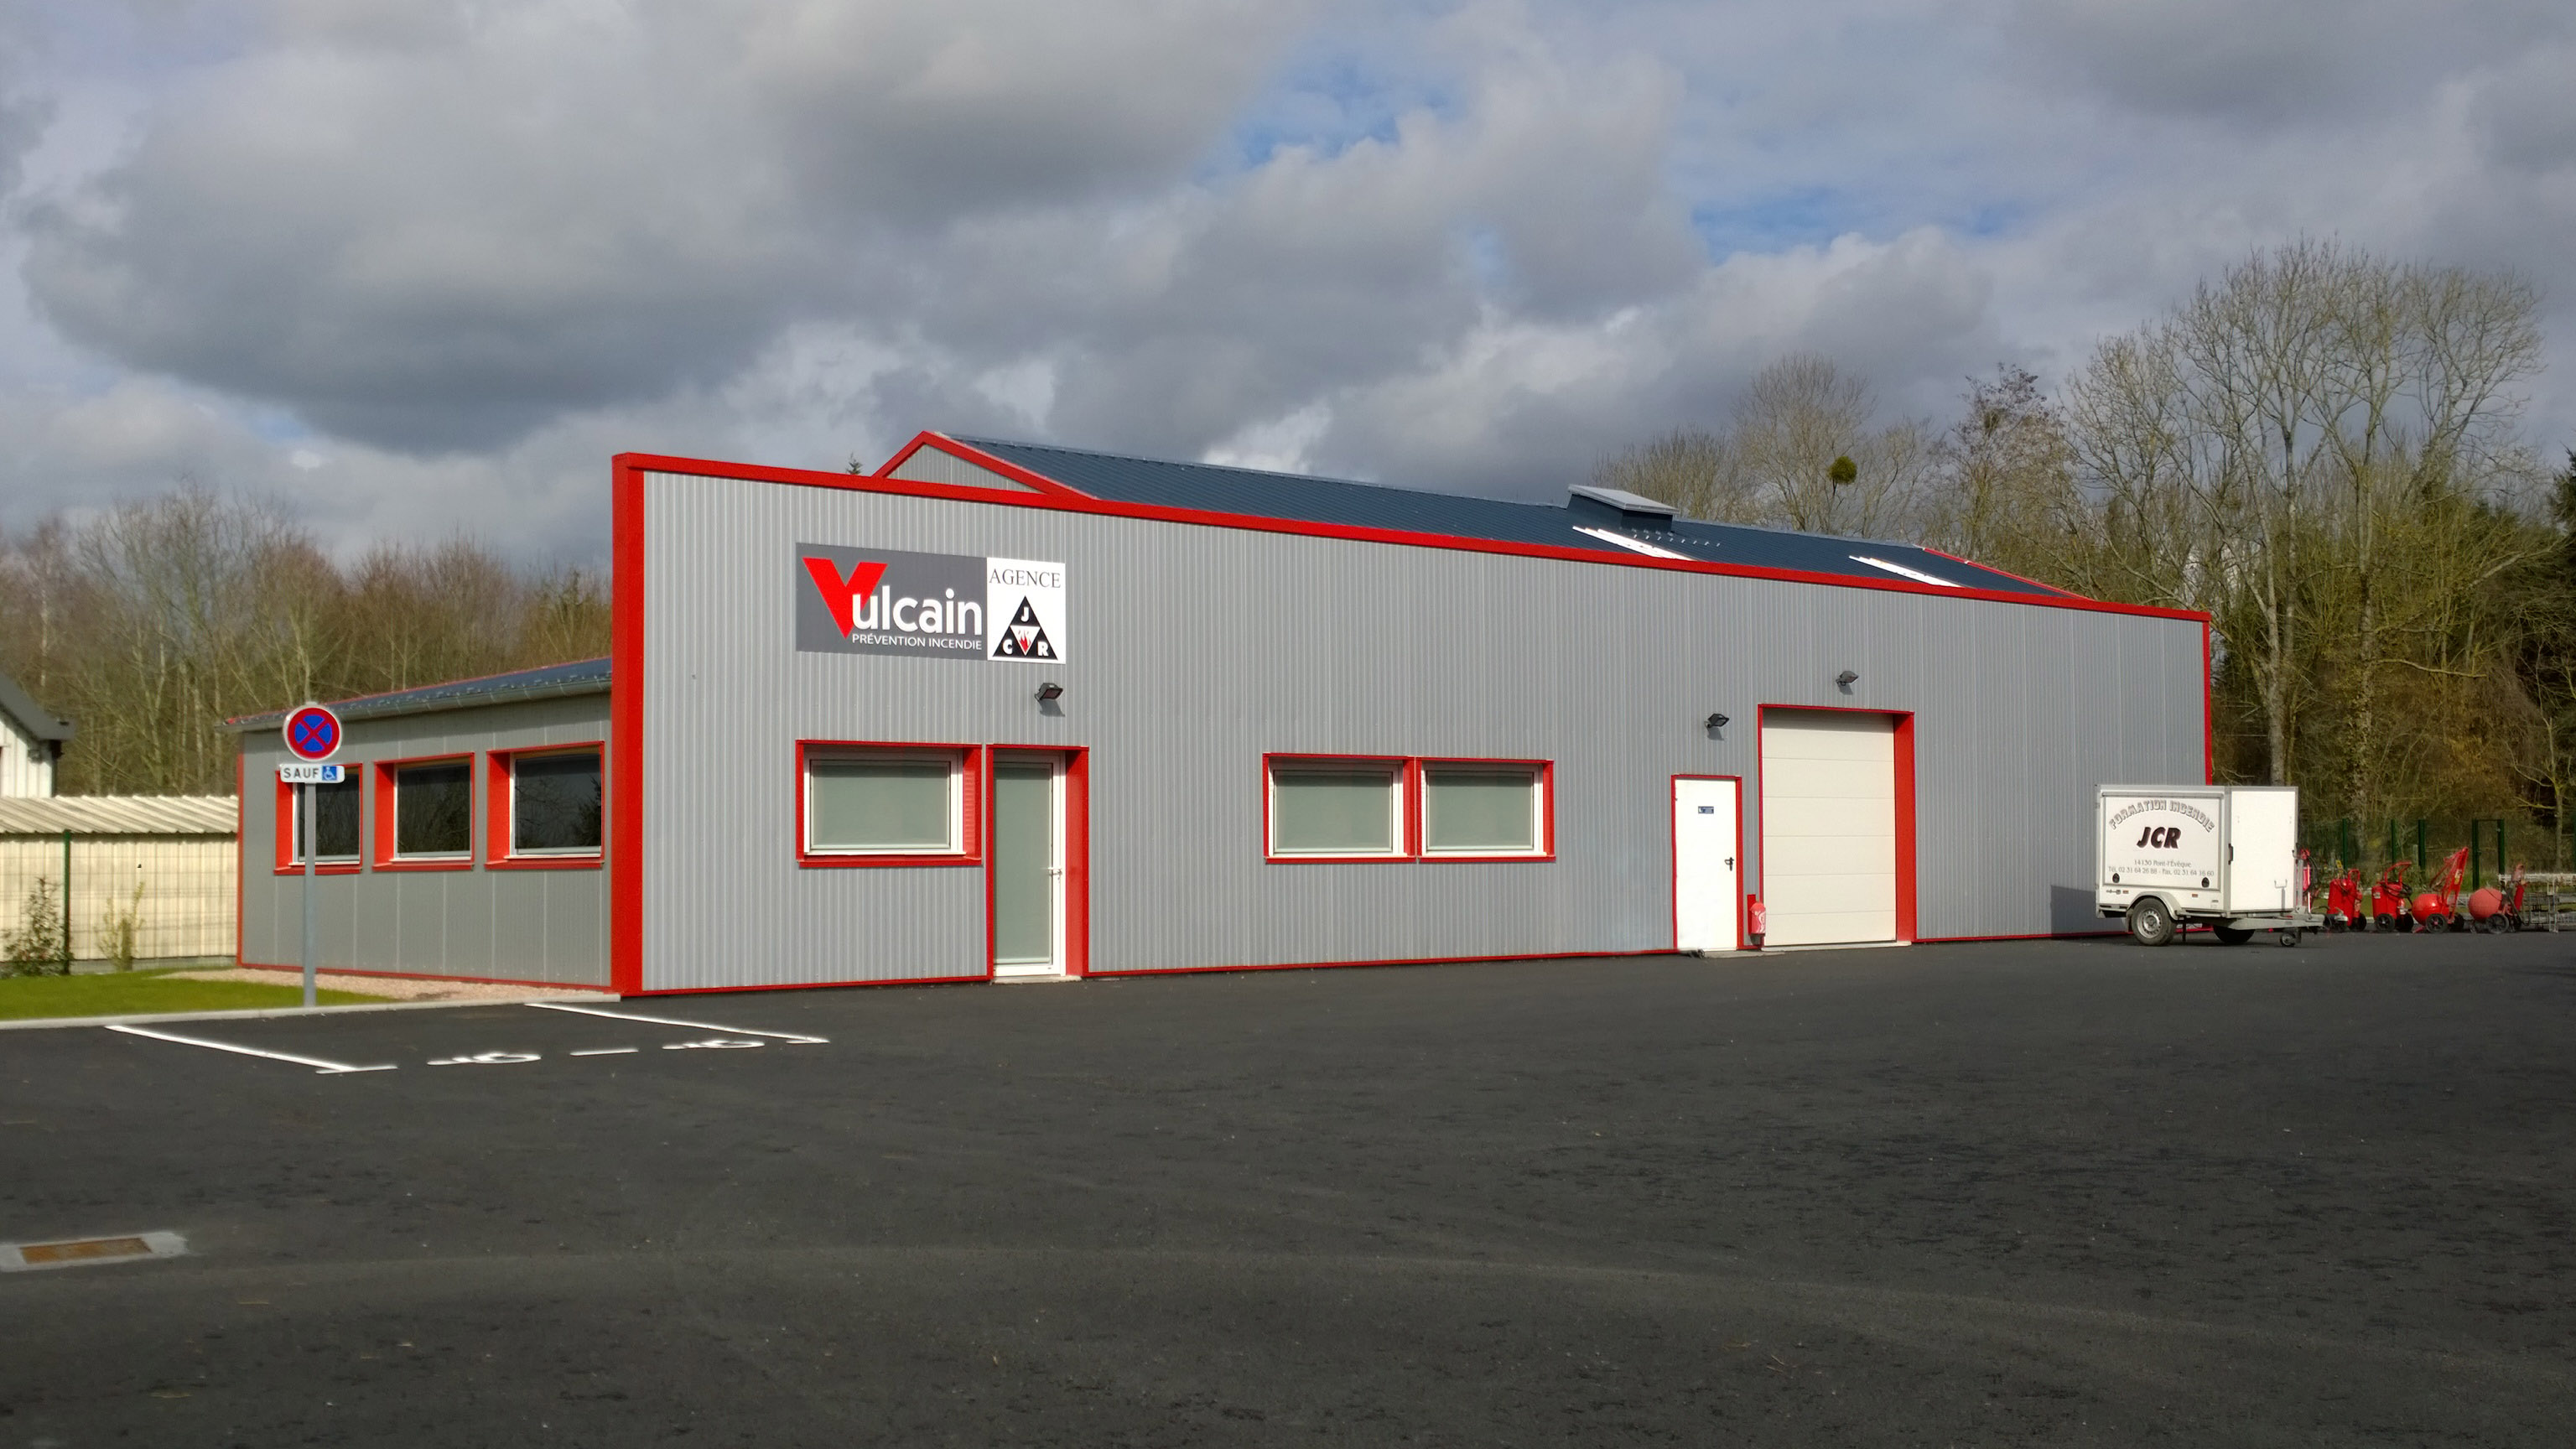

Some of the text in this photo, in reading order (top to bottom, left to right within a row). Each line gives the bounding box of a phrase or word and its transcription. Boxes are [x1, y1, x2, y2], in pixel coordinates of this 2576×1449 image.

[989, 569, 1061, 589] AGENCE
[802, 557, 983, 640] Vulcain
[1021, 606, 1030, 622] J
[852, 632, 983, 650] PRÉVENTION INCENDIE
[1002, 641, 1049, 657] C R
[283, 767, 319, 778] SAUF
[2109, 799, 2215, 833] FORMATION INCENDIE
[2137, 827, 2182, 849] JCR
